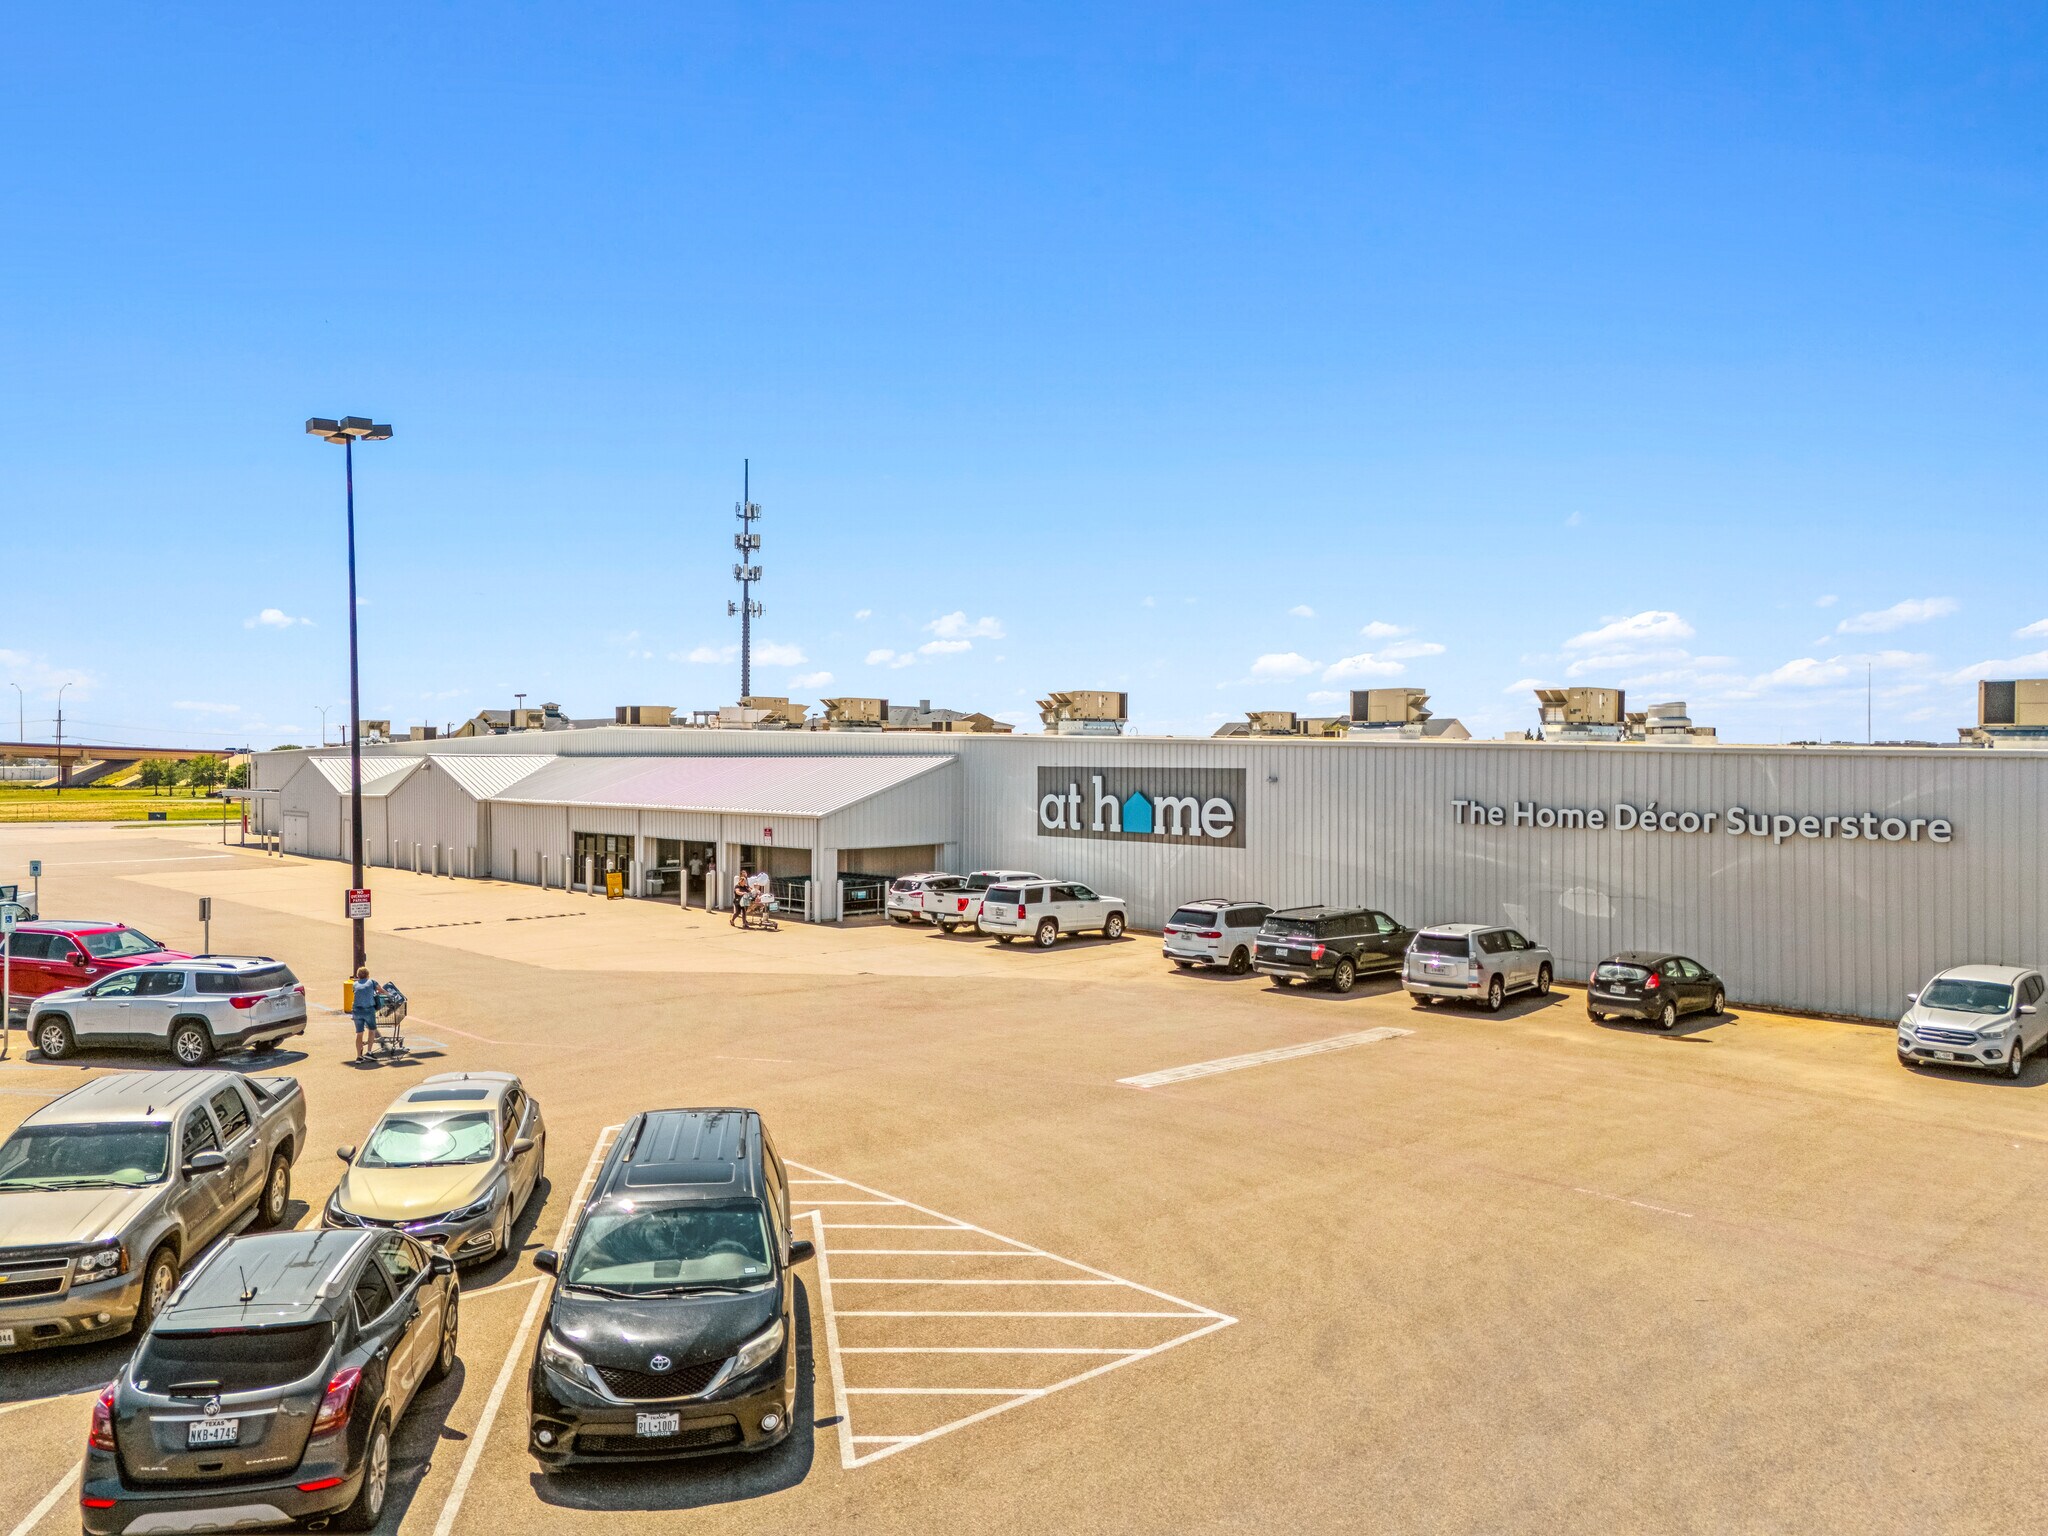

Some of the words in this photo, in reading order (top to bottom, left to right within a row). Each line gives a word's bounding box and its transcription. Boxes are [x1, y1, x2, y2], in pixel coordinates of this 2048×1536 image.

[1040, 783, 1082, 831] at
[1450, 800, 1506, 826] The
[1513, 801, 1606, 830] Home
[1614, 801, 1718, 834] Décor
[1726, 806, 1953, 844] Superstore
